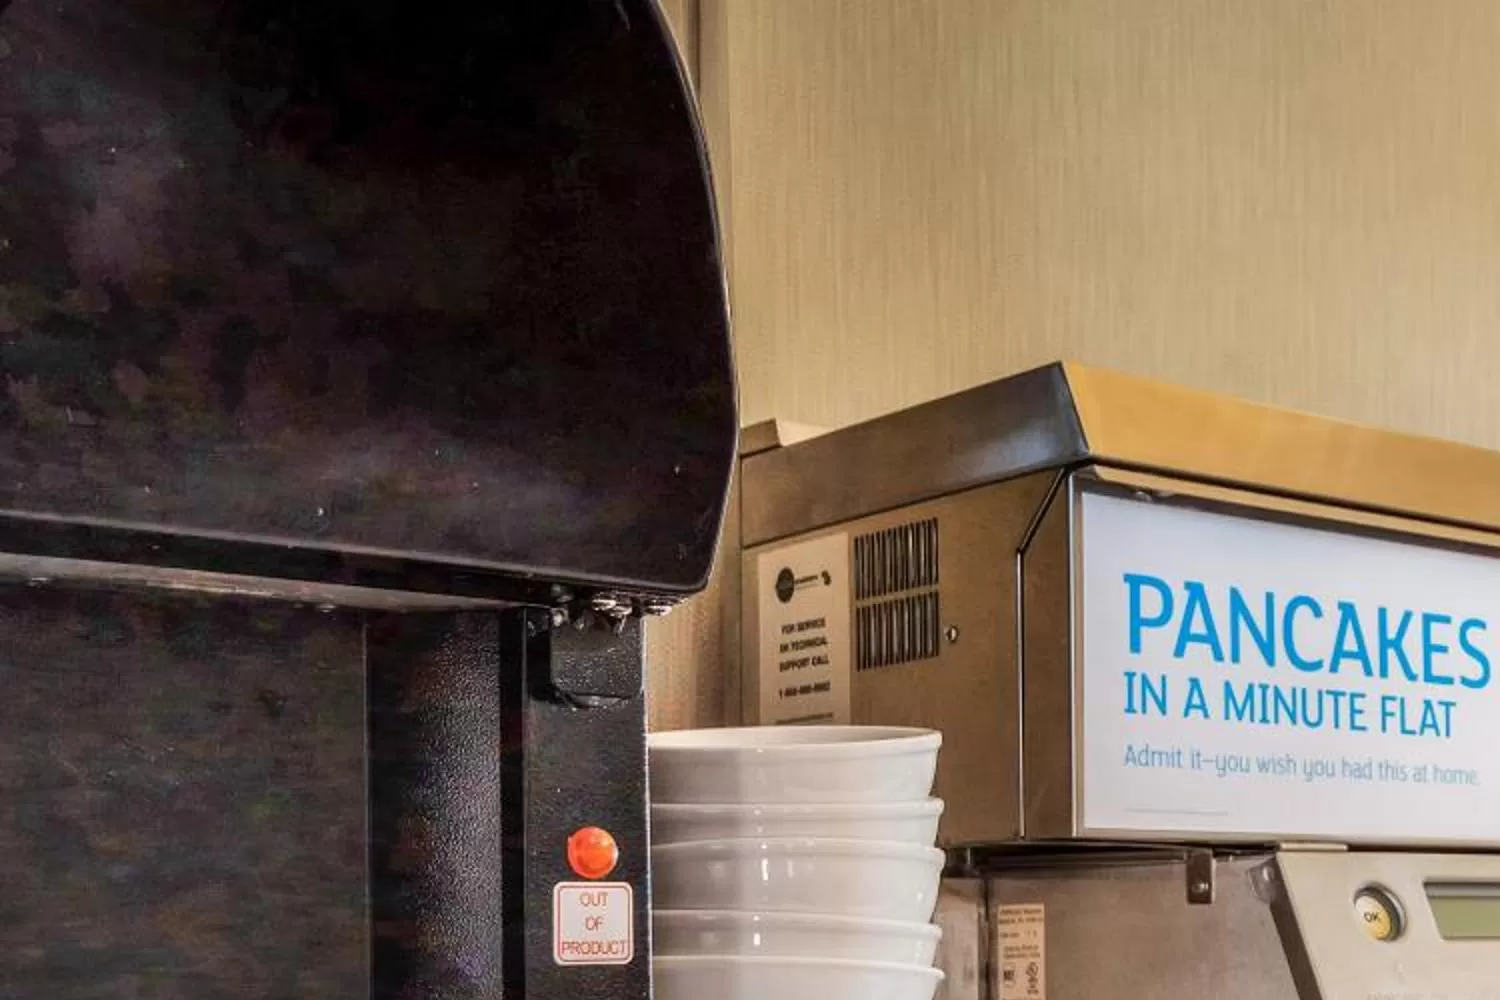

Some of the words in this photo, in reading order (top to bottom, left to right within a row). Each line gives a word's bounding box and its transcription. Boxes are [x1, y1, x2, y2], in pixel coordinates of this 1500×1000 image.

[1123, 572, 1492, 689] PANCAKES
[1124, 671, 1167, 717] IN
[1182, 677, 1210, 719] A
[1224, 680, 1369, 732] MINUTE
[1380, 695, 1457, 738] FLAT
[1123, 743, 1184, 769] Admit
[1256, 753, 1297, 775] wish
[1302, 758, 1335, 782] you
[1342, 757, 1373, 781] had
[1378, 761, 1408, 782] this
[1412, 763, 1430, 783] at
[580, 892, 608, 906] OUT
[585, 915, 604, 931] OF
[1364, 911, 1381, 923] OK
[561, 940, 626, 955] PRODUCT
